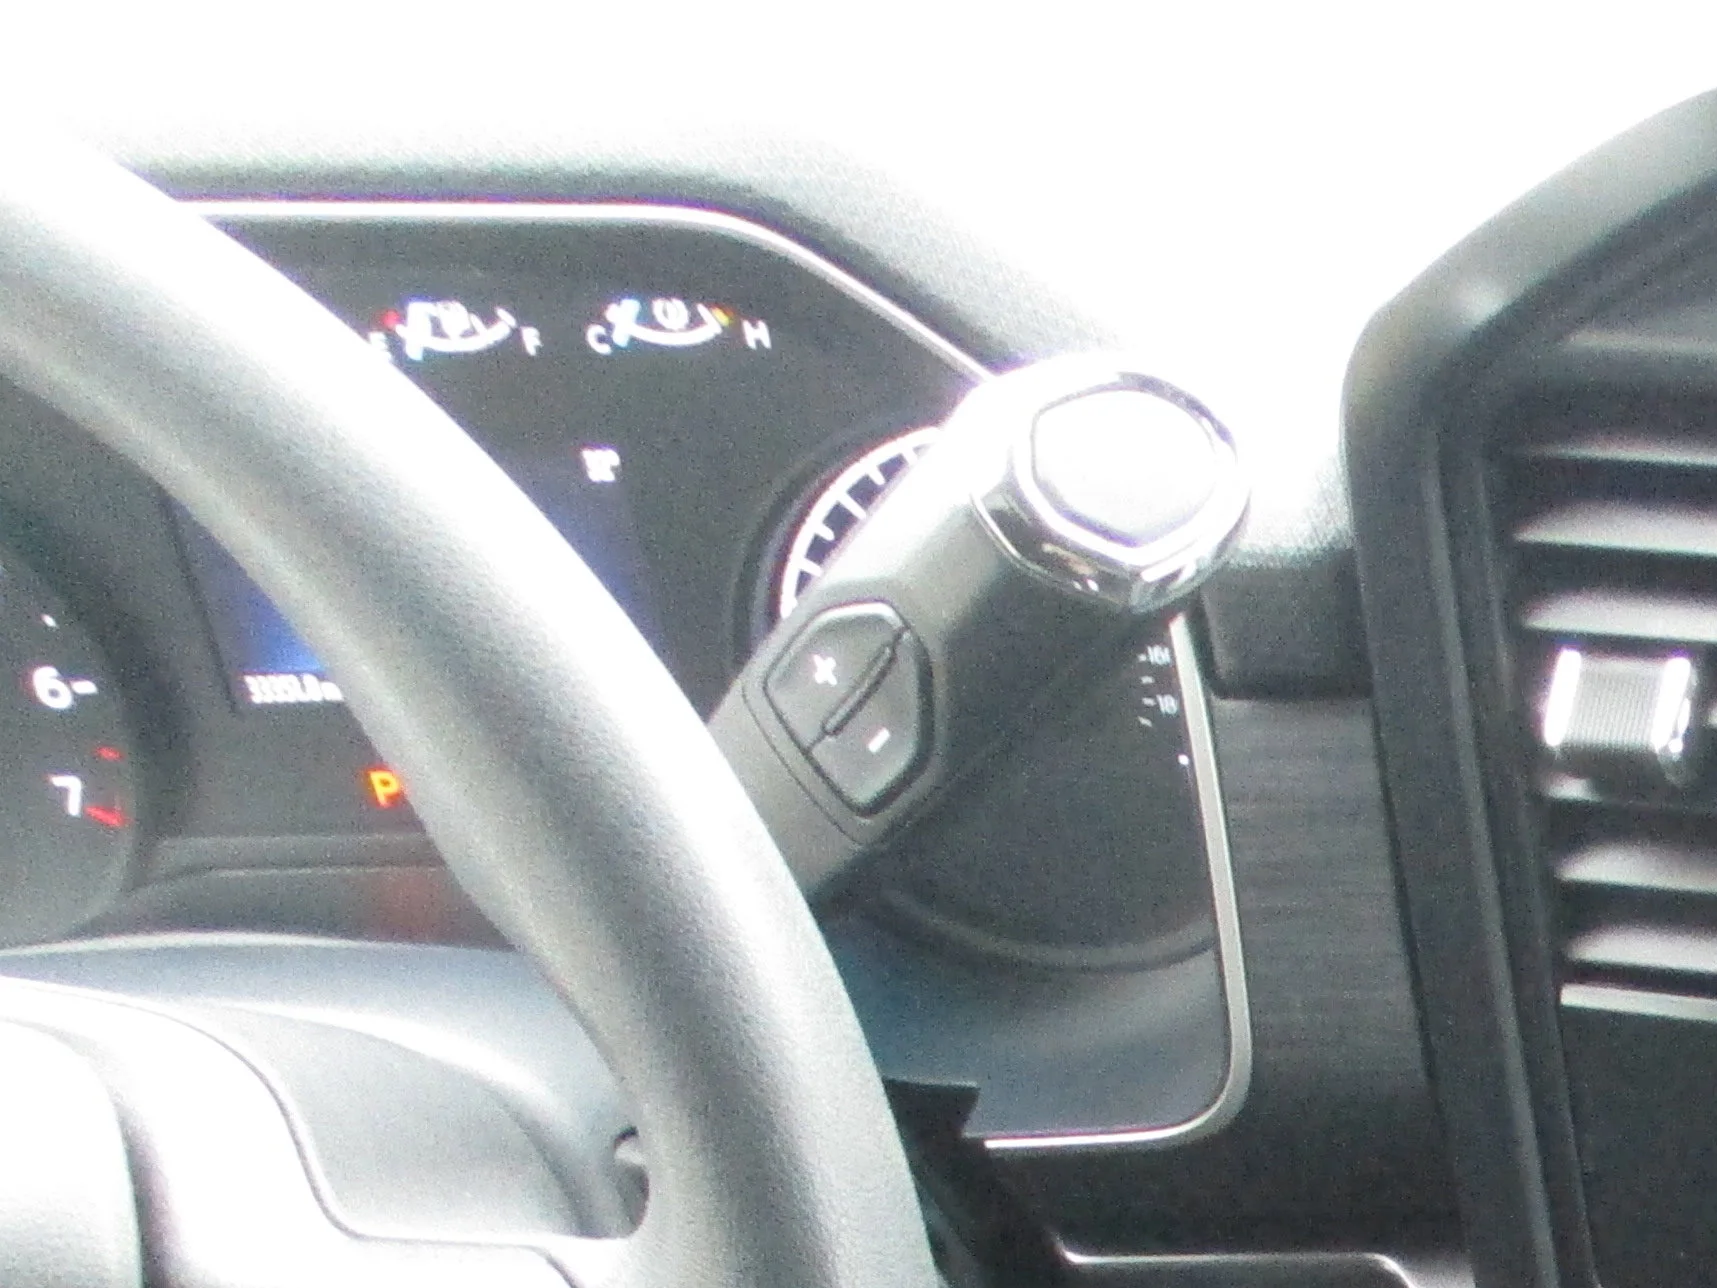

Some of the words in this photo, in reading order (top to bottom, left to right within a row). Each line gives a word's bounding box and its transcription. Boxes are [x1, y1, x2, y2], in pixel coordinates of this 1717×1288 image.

[586, 324, 612, 355] C
[741, 319, 772, 350] H
[31, 665, 75, 710] 6
[48, 774, 84, 818] 7
[367, 768, 403, 808] P
